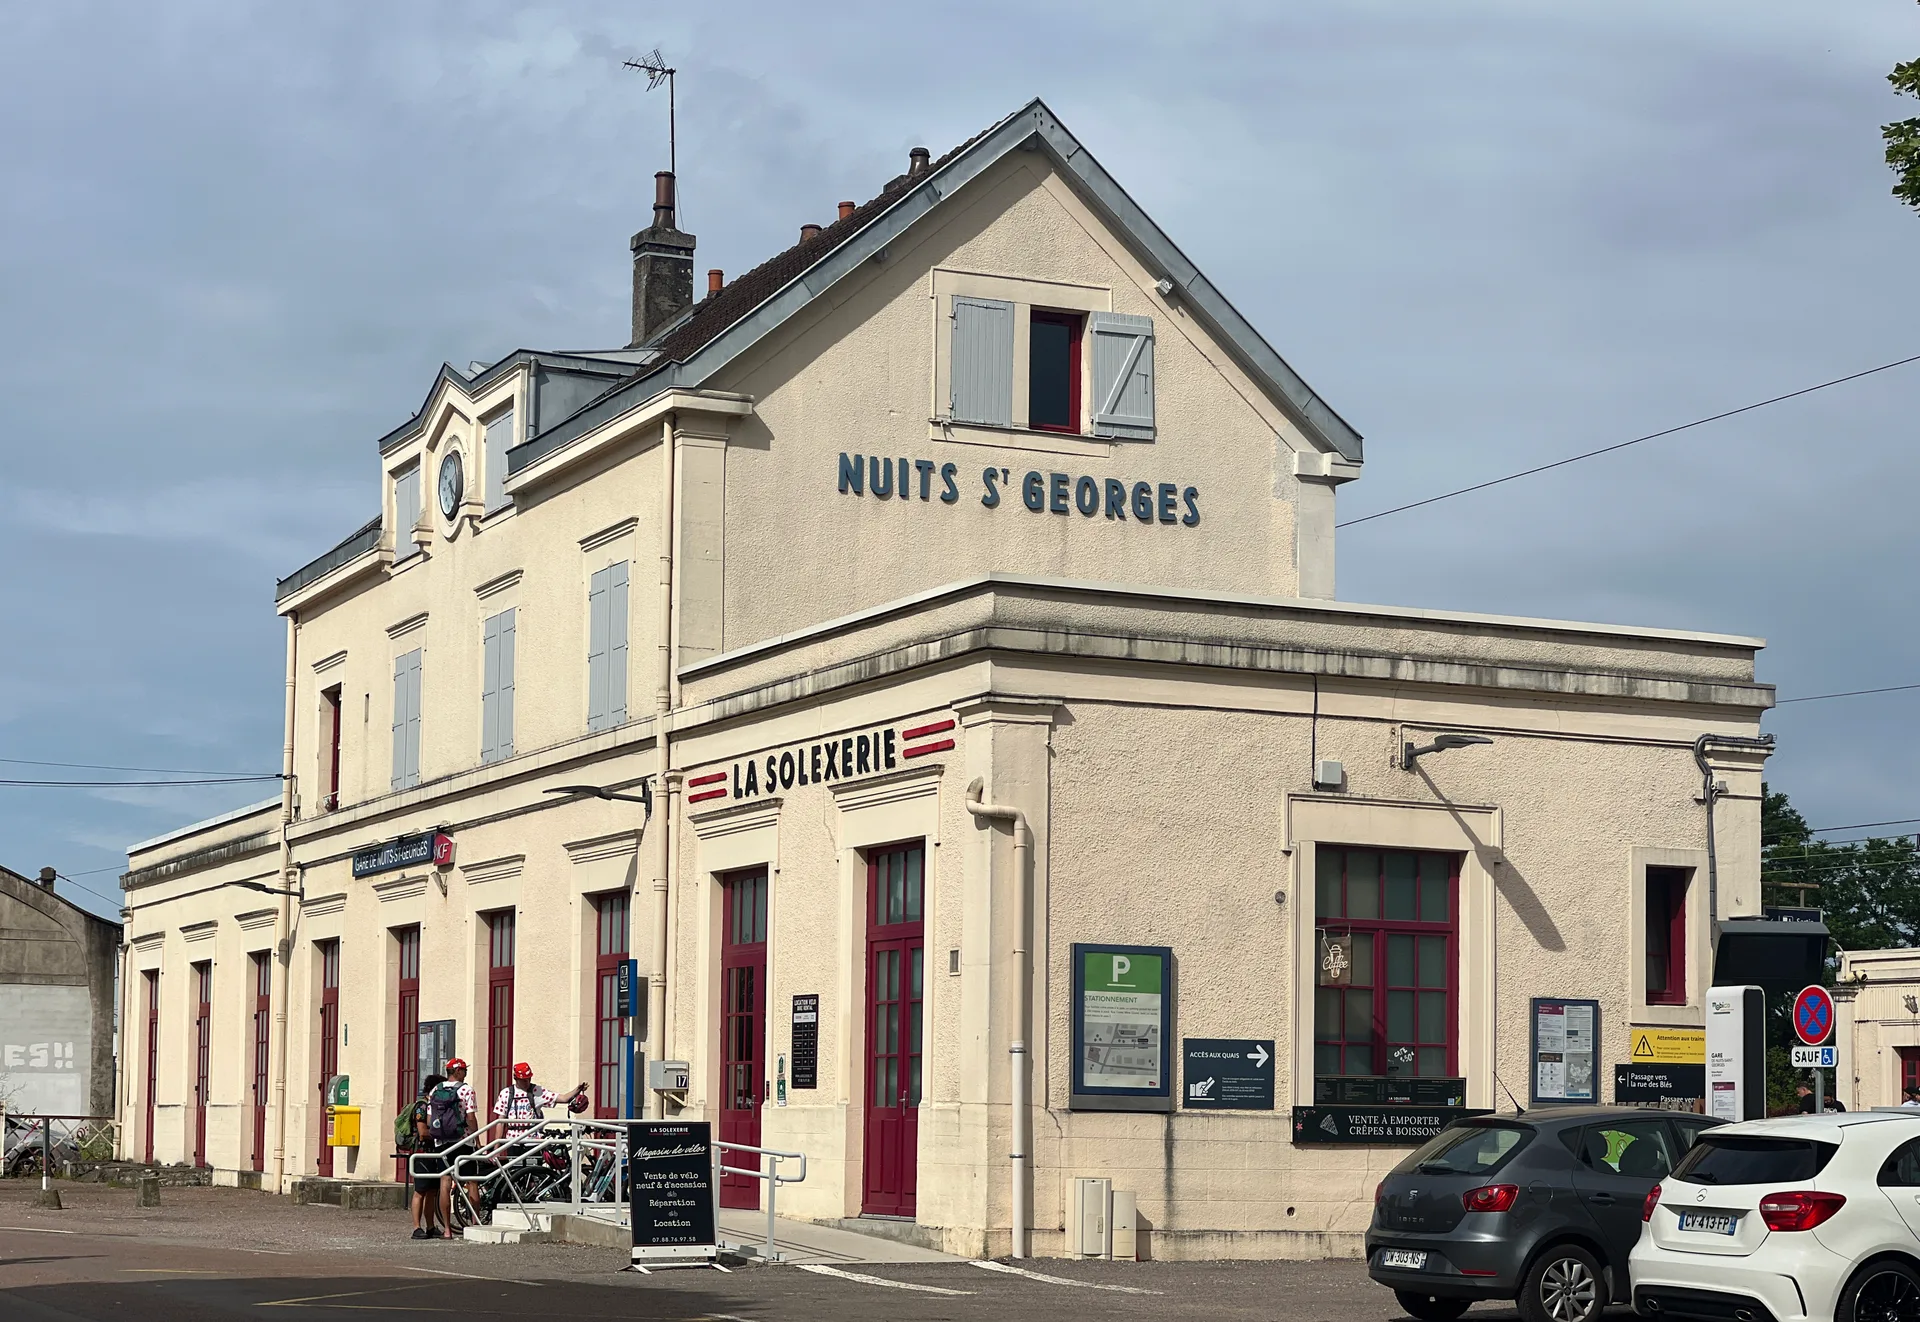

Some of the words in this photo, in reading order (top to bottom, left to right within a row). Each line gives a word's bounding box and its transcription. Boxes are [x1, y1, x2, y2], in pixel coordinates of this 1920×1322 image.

[838, 452, 959, 505] NUITS
[1022, 470, 1201, 526] GEORGES
[733, 759, 759, 800] LA
[765, 728, 896, 794] SOLEXERIE
[355, 854, 369, 871] GARE
[369, 853, 377, 868] DE
[1112, 955, 1131, 982] P
[1084, 995, 1138, 1004] STATIONNEMENT
[0, 1042, 74, 1069] ES!!
[1794, 1051, 1820, 1063] SAUF
[677, 1076, 687, 1087] 17
[1630, 1073, 1654, 1081] Passage
[1348, 1115, 1380, 1125] VENTE
[1381, 1113, 1388, 1125] À
[1390, 1116, 1440, 1126] EMPORTER
[1349, 1125, 1384, 1136] CRÊPES
[1386, 1126, 1393, 1136] &
[1395, 1126, 1441, 1136] BOISSONS
[633, 1147, 670, 1160] Magasin
[671, 1144, 684, 1155] de
[683, 1143, 707, 1154] vélos
[643, 1172, 667, 1180] Vente
[668, 1172, 679, 1180] de
[680, 1171, 699, 1180] vélo
[649, 1199, 696, 1208] Réparation
[653, 1219, 691, 1228] Location
[1685, 1214, 1730, 1230] CV-413-FP
